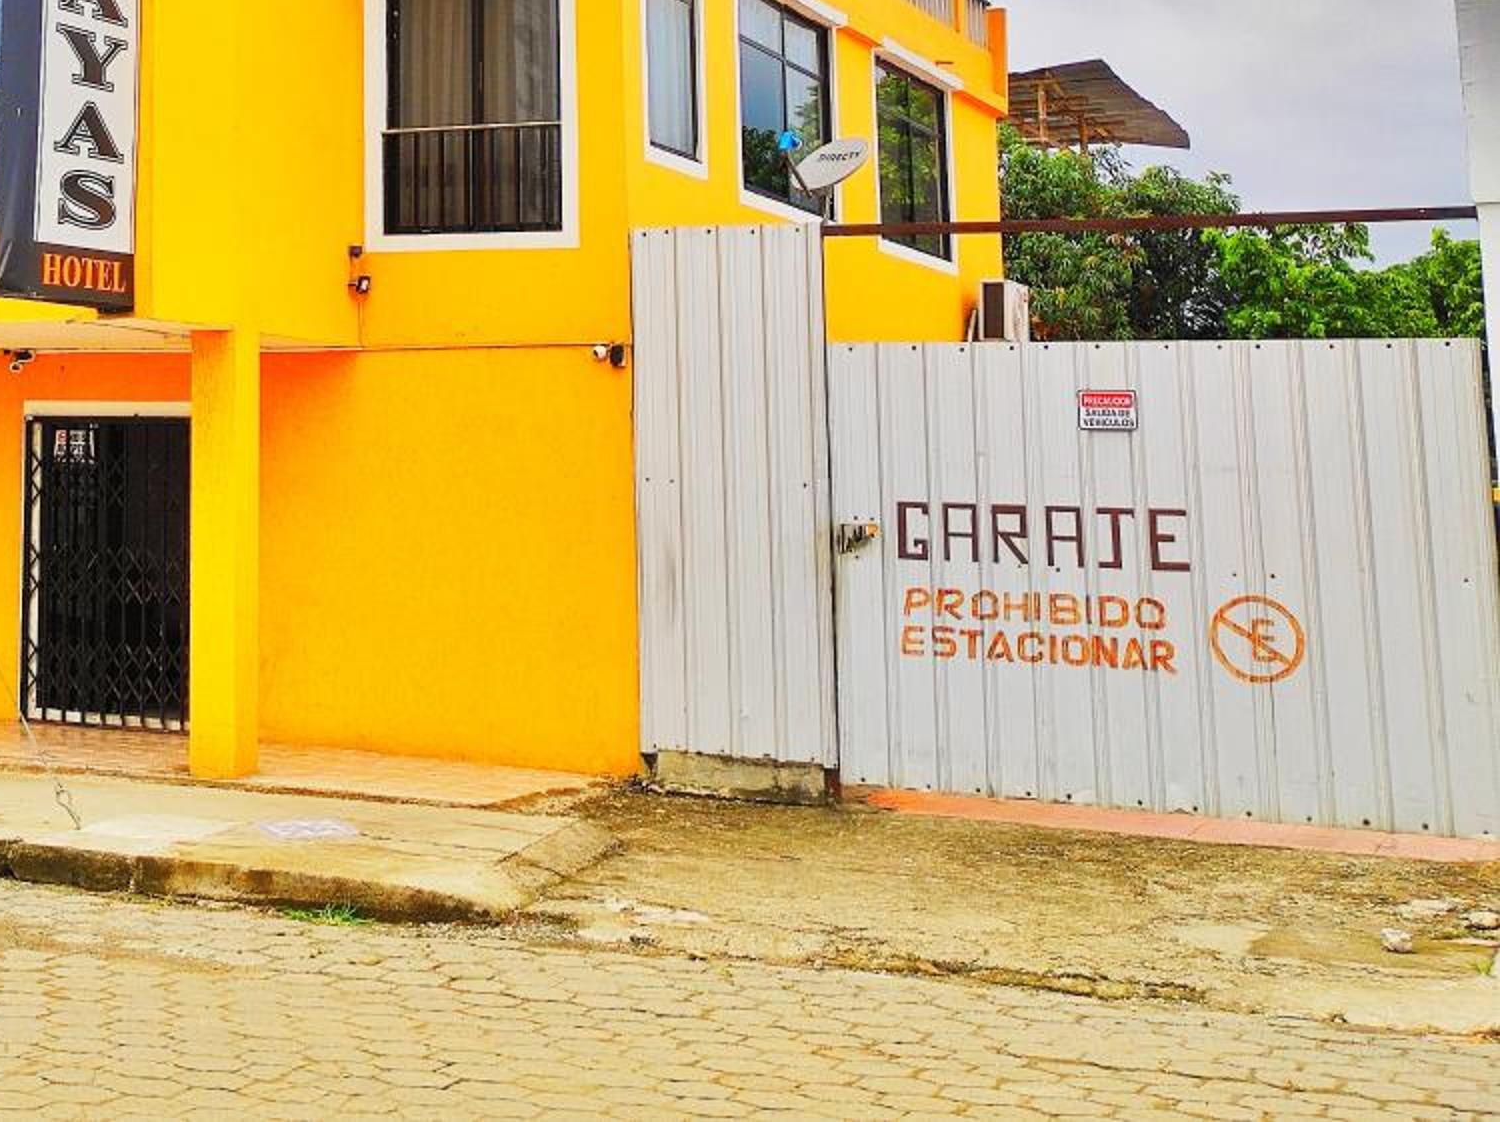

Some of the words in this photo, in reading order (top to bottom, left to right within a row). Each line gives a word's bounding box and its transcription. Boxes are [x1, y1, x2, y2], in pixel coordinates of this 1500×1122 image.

[42, 253, 126, 293] HOTEL
[897, 502, 1190, 571] GARAJE
[903, 587, 1167, 630] PROHIBIDO
[901, 626, 1178, 674] ESTACIONAR
